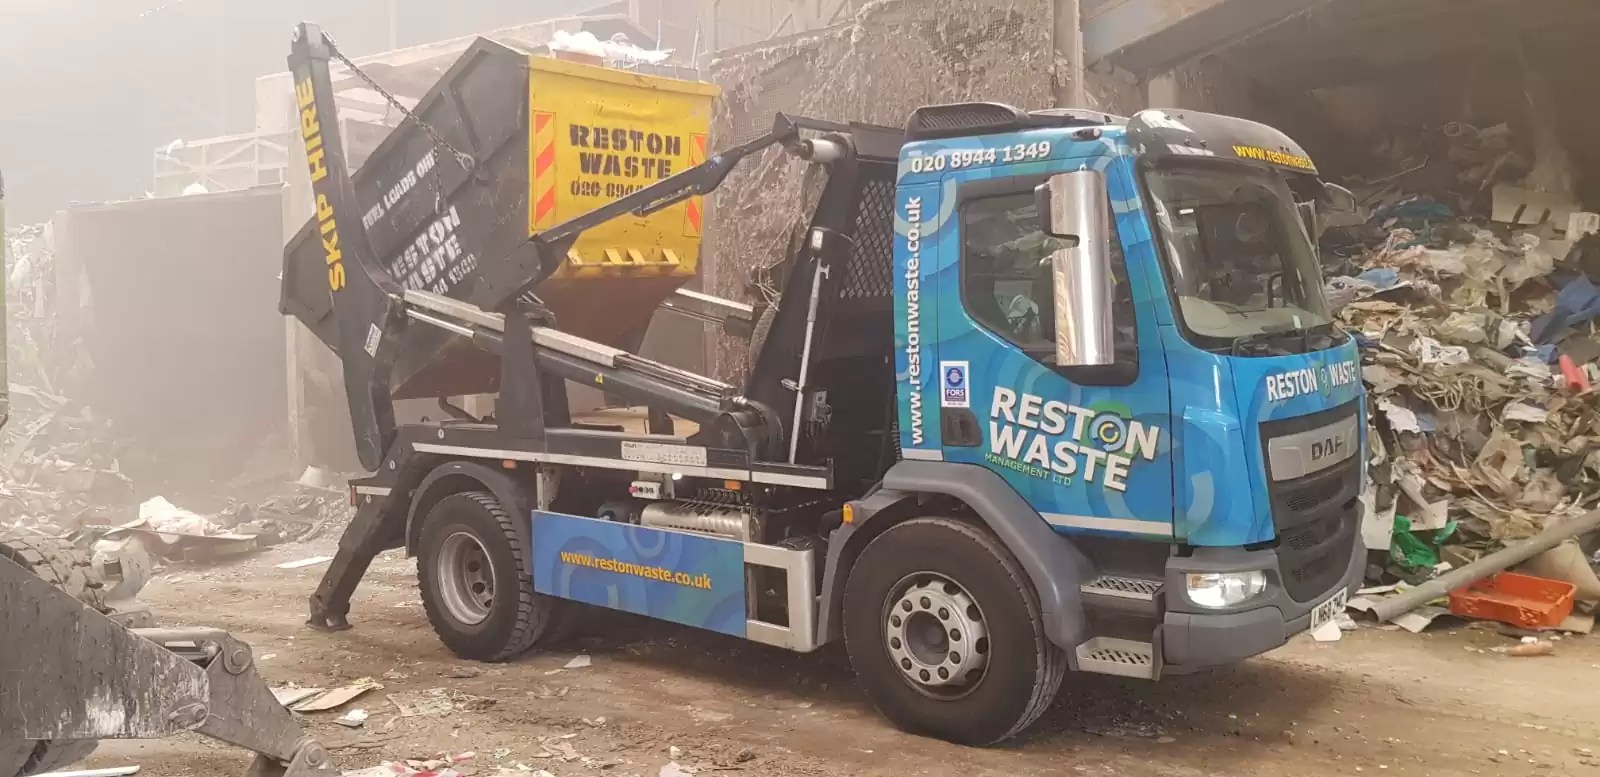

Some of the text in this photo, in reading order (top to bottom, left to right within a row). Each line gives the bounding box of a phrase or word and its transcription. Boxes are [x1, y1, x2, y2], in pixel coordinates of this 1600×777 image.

[569, 124, 681, 156] RESTON
[910, 140, 1051, 173] 020 8944 1349
[296, 76, 346, 291] SKIP HIRE
[579, 152, 672, 179] WASTE
[383, 170, 417, 210] LOADS
[387, 205, 461, 279] ESTON
[904, 196, 924, 445] www.restonwaste.co.uk
[1266, 360, 1357, 402] RESTON WASTE
[990, 385, 1160, 460] RESTON
[989, 420, 1131, 492] WASTE
[1311, 436, 1344, 461] DAF
[985, 452, 1073, 487] MANAGEMENT LTD
[560, 551, 712, 591] www.restonwaste.co.uk
